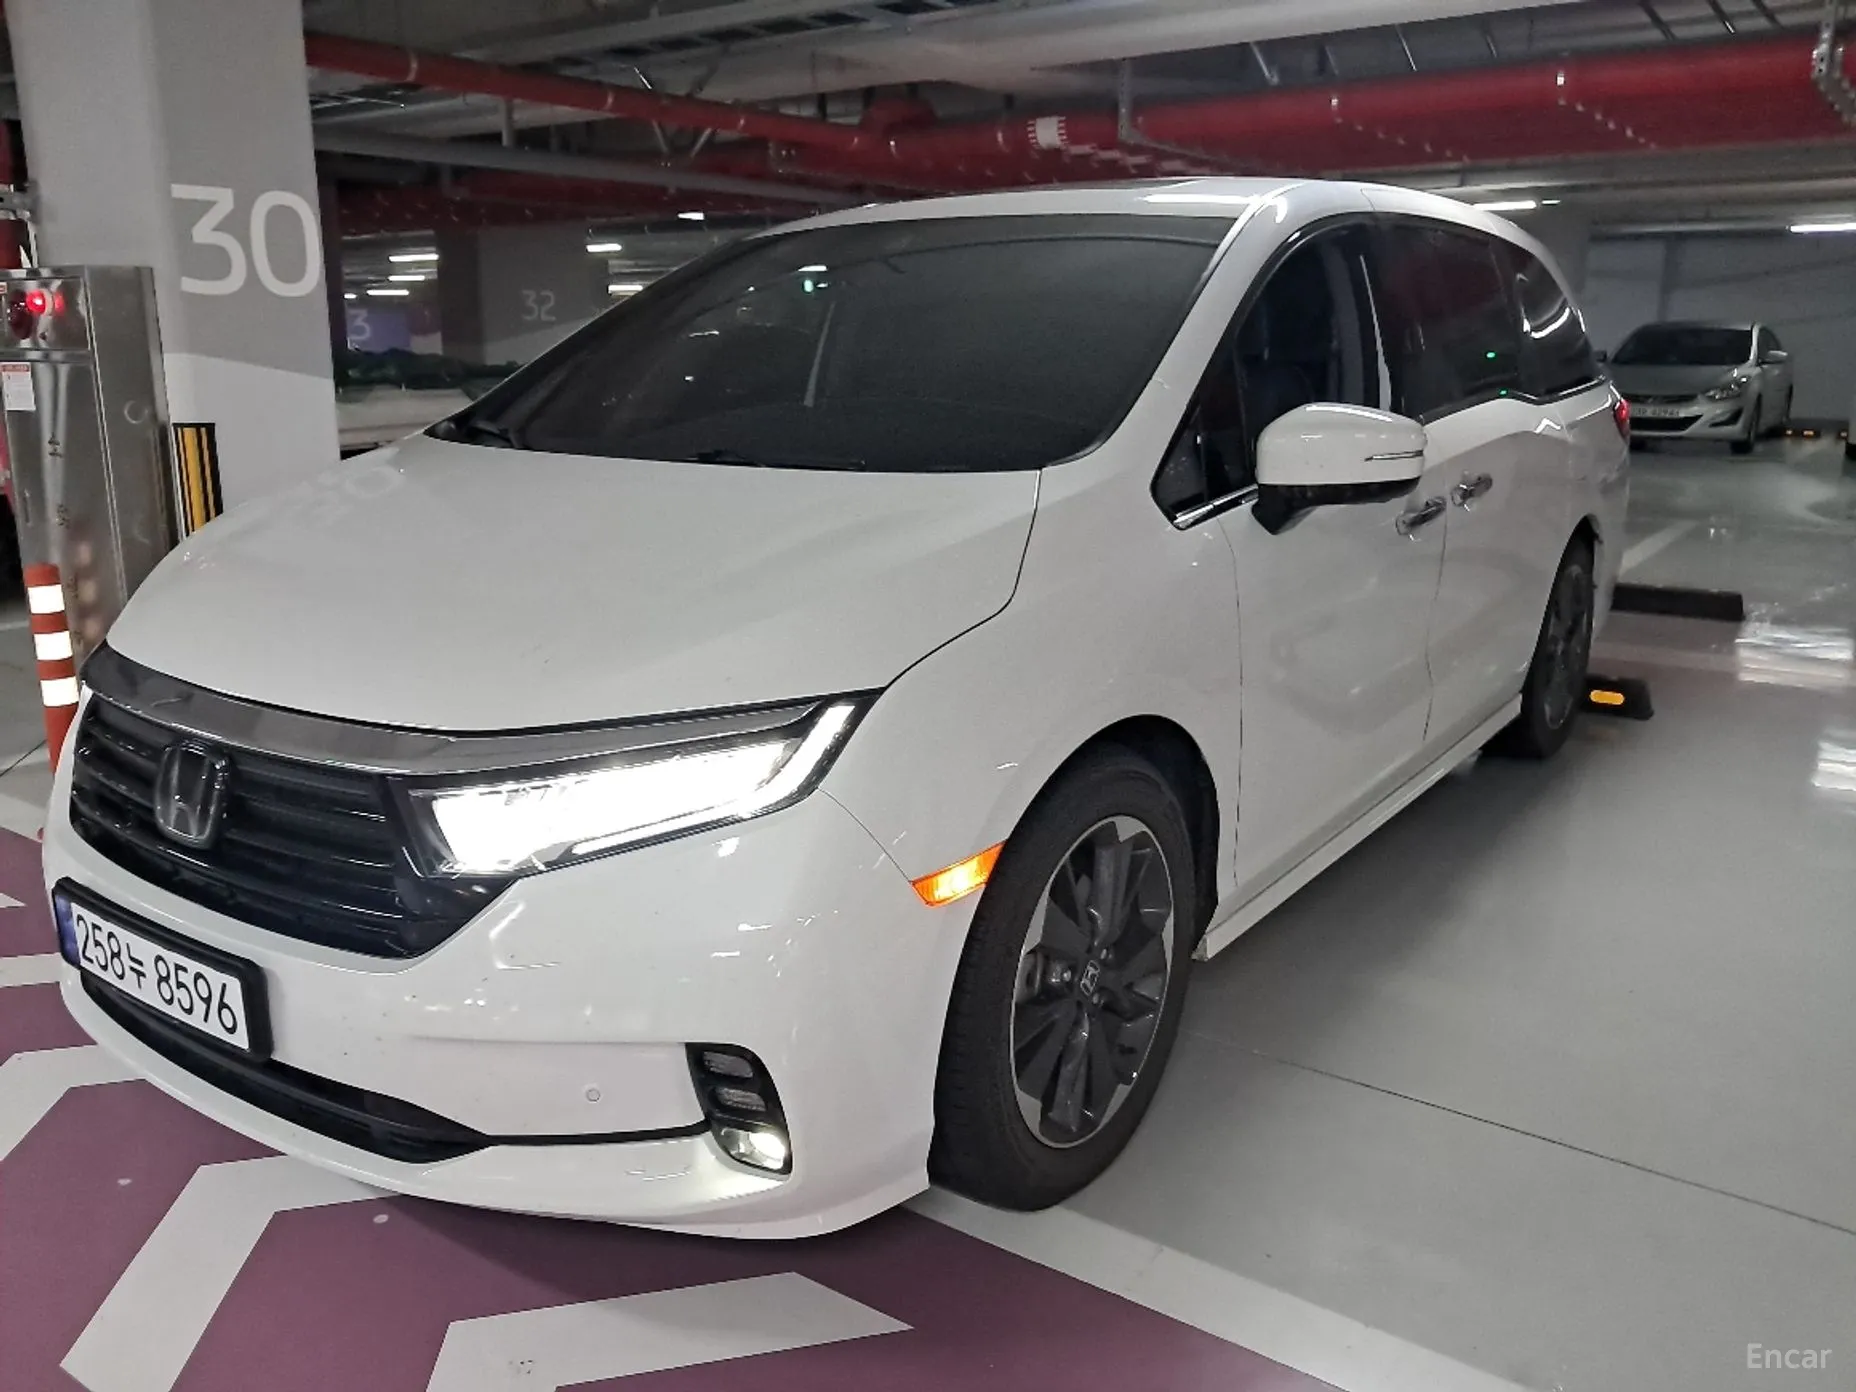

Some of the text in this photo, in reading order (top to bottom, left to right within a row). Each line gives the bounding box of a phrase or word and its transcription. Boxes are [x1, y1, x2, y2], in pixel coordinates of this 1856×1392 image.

[171, 183, 321, 297] 30
[522, 290, 556, 321] 32
[76, 914, 238, 1035] 258누 8596
